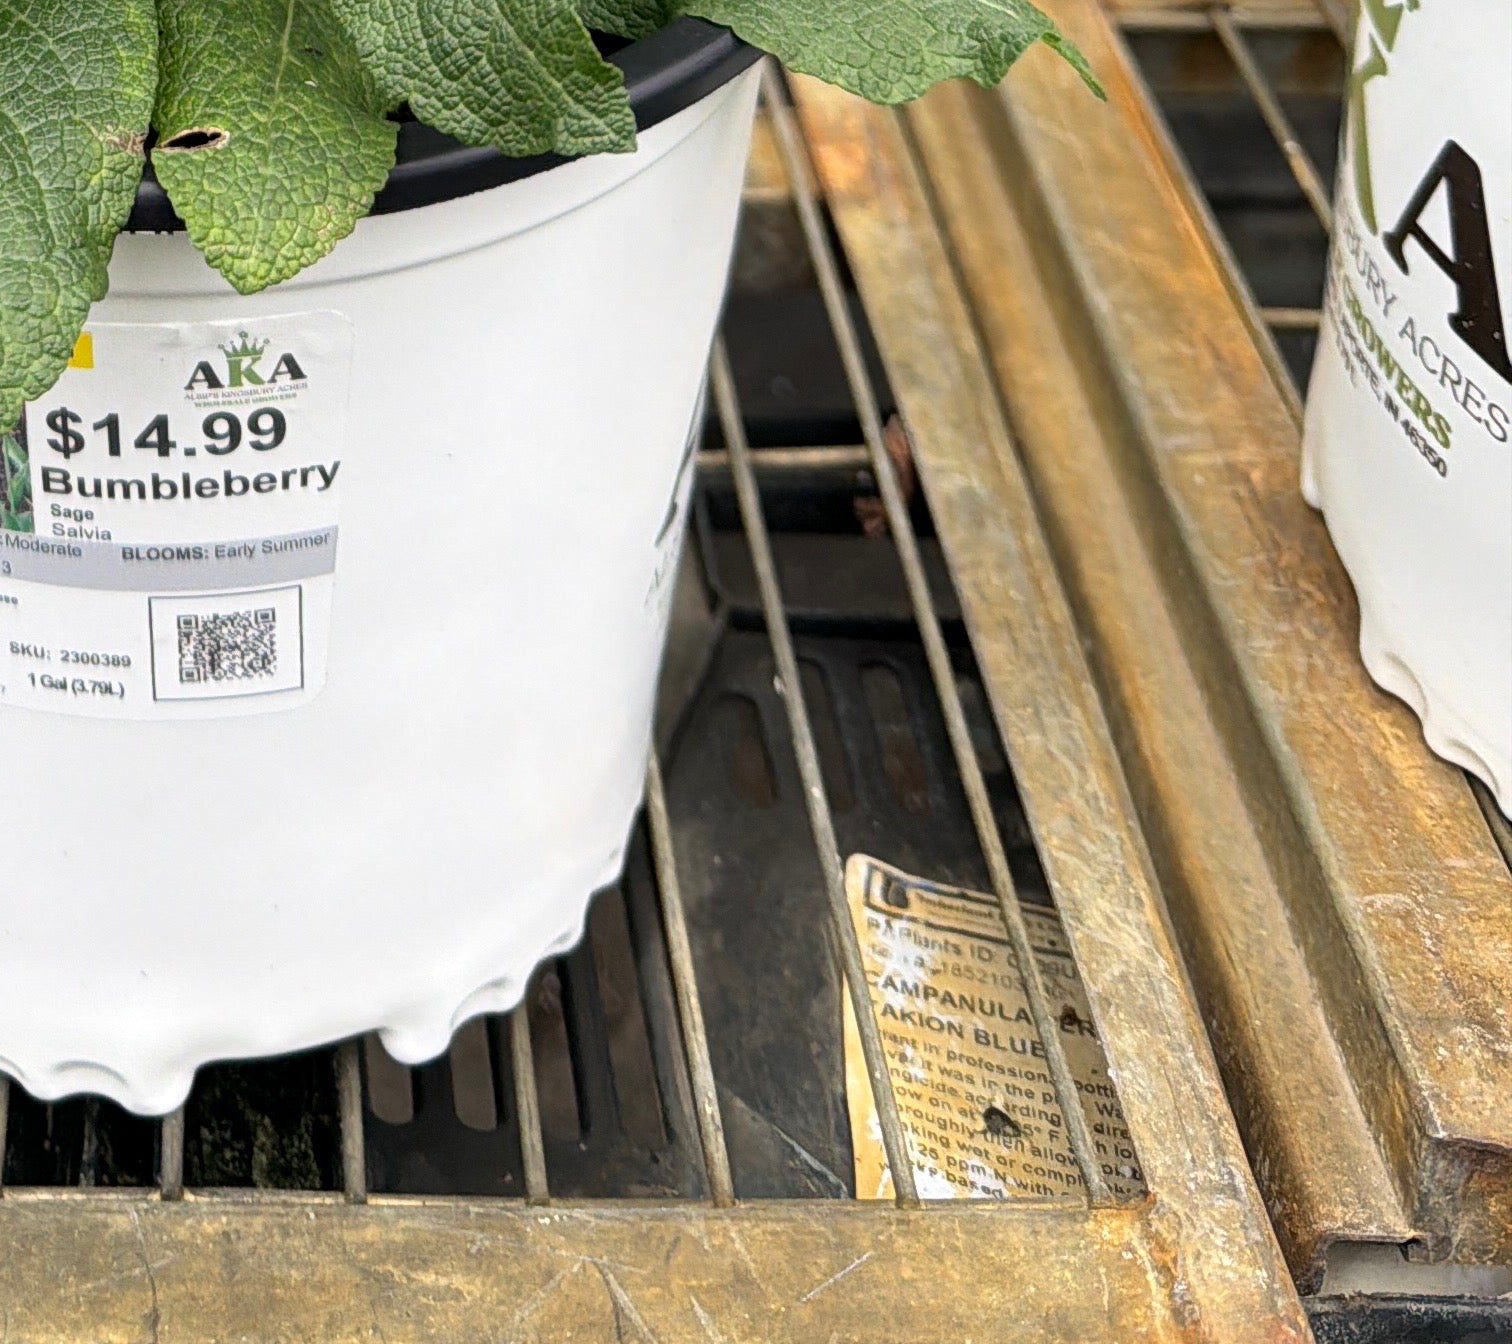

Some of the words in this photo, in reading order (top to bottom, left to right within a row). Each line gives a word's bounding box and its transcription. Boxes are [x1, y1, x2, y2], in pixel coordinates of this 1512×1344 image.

[183, 351, 308, 391] AKA
[1398, 316, 1511, 444] ACRES
[45, 406, 288, 460] $14.99
[41, 460, 341, 500] Bumbleberry
[50, 502, 95, 523] Sage
[5, 528, 84, 559] Moderate
[51, 522, 113, 542] Salvia
[121, 545, 210, 562] BLOOMS:
[214, 542, 257, 561] Early
[260, 531, 330, 556] Summer
[1, 559, 13, 576] 3
[8, 640, 52, 662] SKU:
[59, 648, 133, 668] 2300389
[26, 670, 36, 688] 1
[40, 672, 68, 691] Gal
[71, 678, 126, 700] (3.79L)
[881, 1002, 966, 1039] AKION
[973, 1027, 1046, 1058] BLUE
[890, 1067, 960, 1097] ngicide
[946, 1049, 1054, 1086] profession
[895, 1085, 922, 1102] ow
[928, 1095, 953, 1112] on
[1005, 1081, 1036, 1100] the
[945, 1152, 986, 1178] ppm
[1014, 1174, 1054, 1197] with
[995, 1152, 1016, 1169] or
